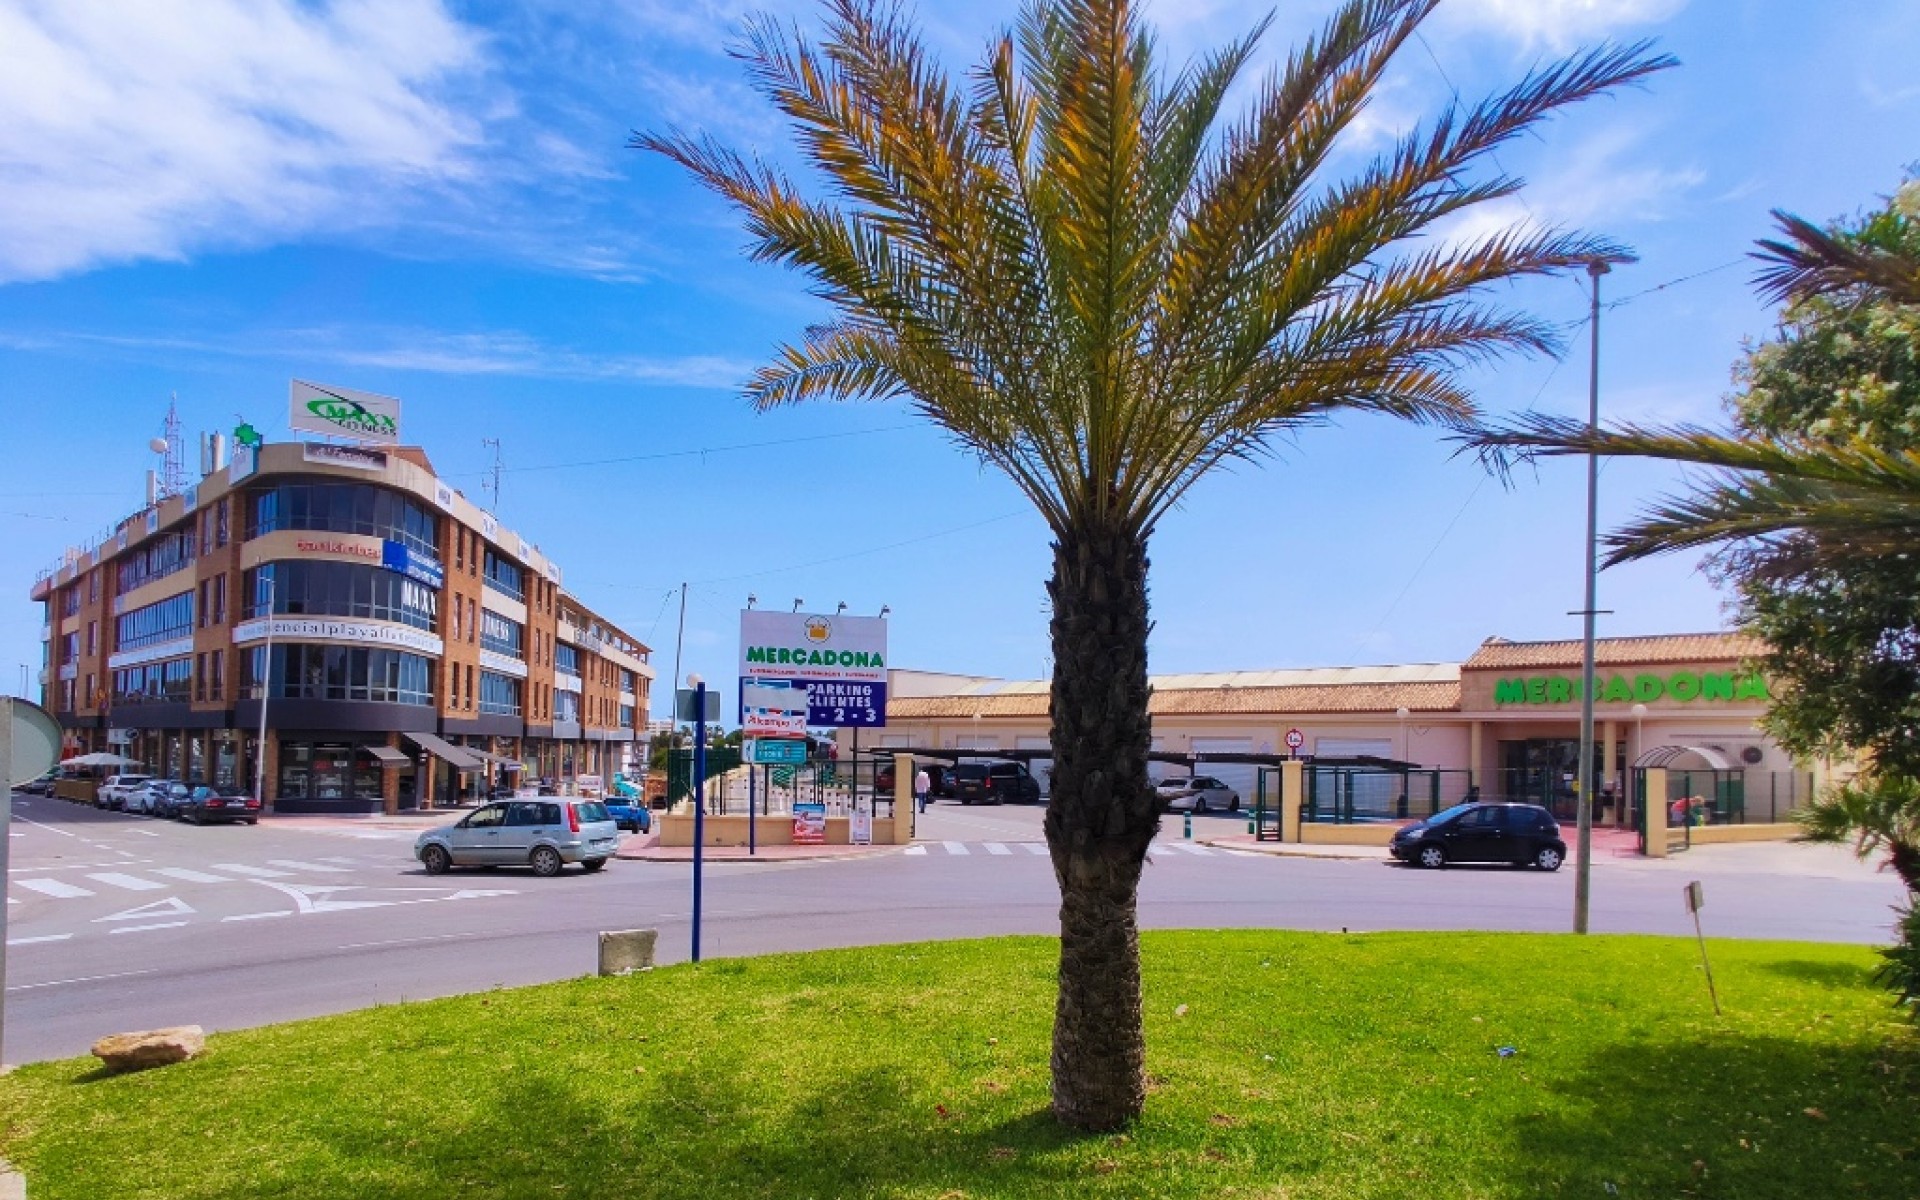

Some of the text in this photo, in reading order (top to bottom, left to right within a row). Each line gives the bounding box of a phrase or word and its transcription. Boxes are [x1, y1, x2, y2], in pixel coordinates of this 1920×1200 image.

[746, 646, 884, 668] MERCADONA
[806, 684, 873, 696] PARKING
[1494, 670, 1769, 705] MERCADONA
[806, 696, 872, 708] CLIENTES
[833, 707, 845, 722] 2
[865, 707, 877, 722] 3
